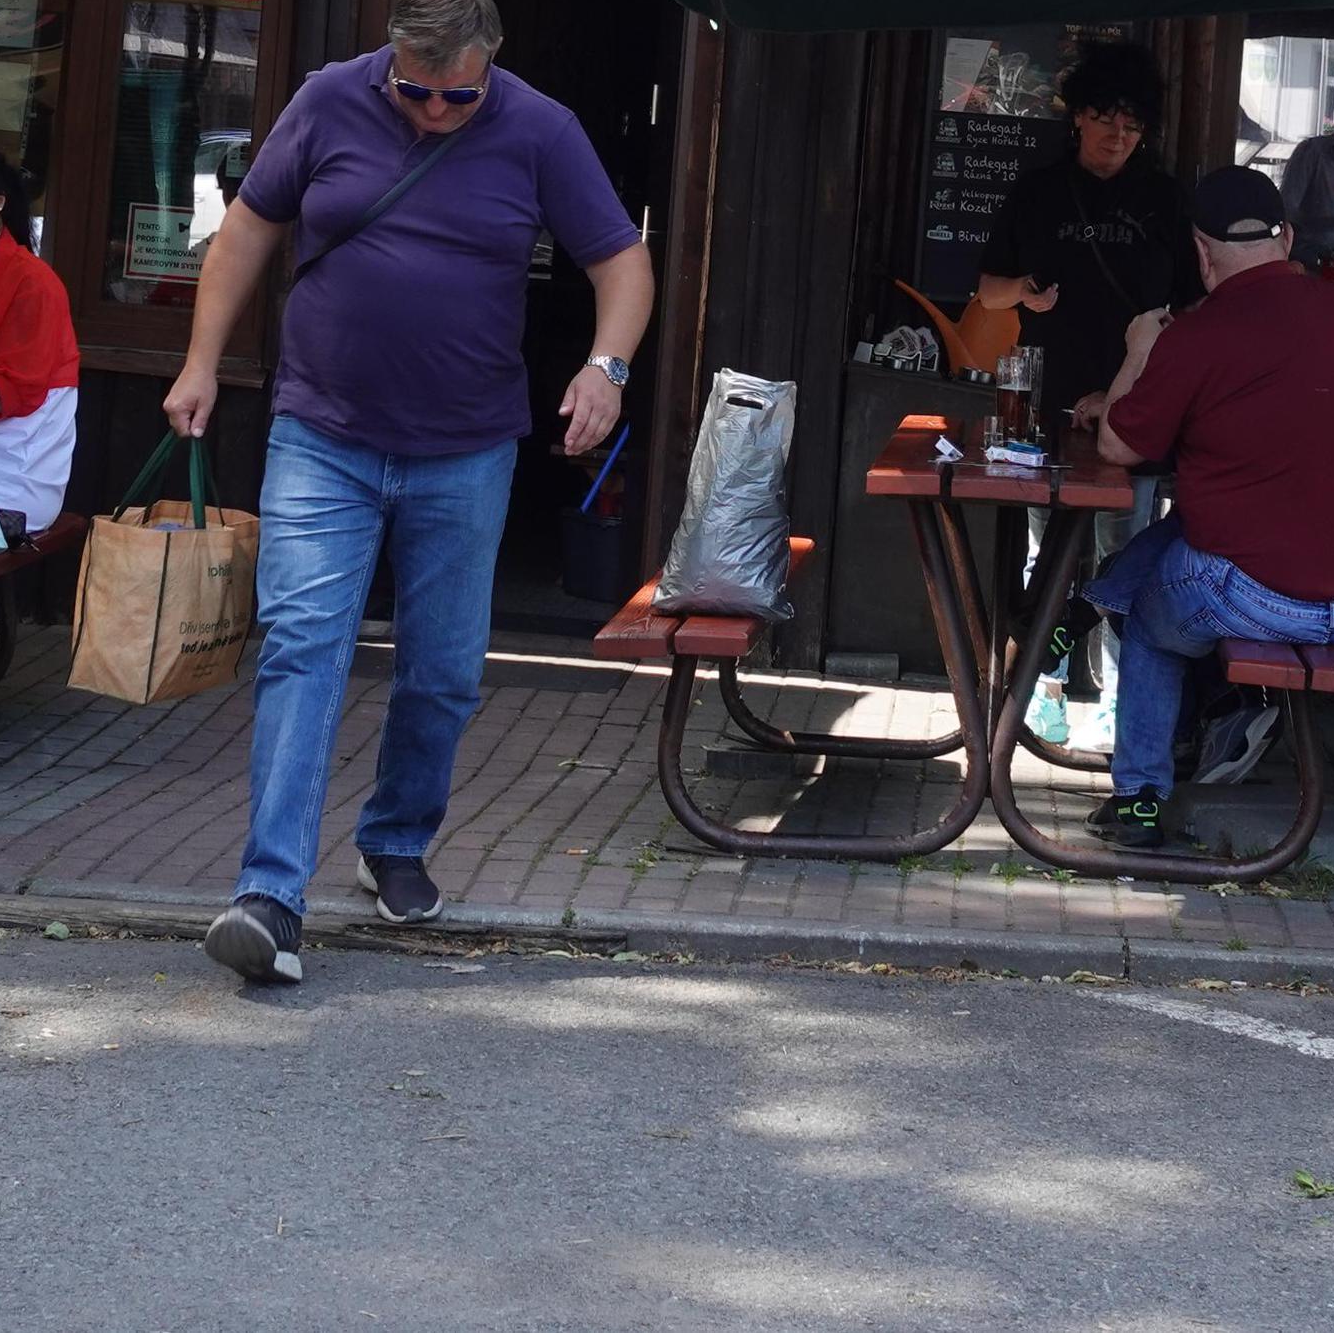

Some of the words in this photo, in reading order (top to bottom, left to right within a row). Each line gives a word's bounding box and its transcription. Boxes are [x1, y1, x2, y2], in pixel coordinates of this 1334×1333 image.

[967, 119, 1023, 138] Radegast
[1024, 136, 1037, 148] 12
[964, 155, 1020, 174] Radegast
[1002, 171, 1018, 182] 10
[959, 199, 994, 215] Kozel
[138, 222, 161, 230] TENTO
